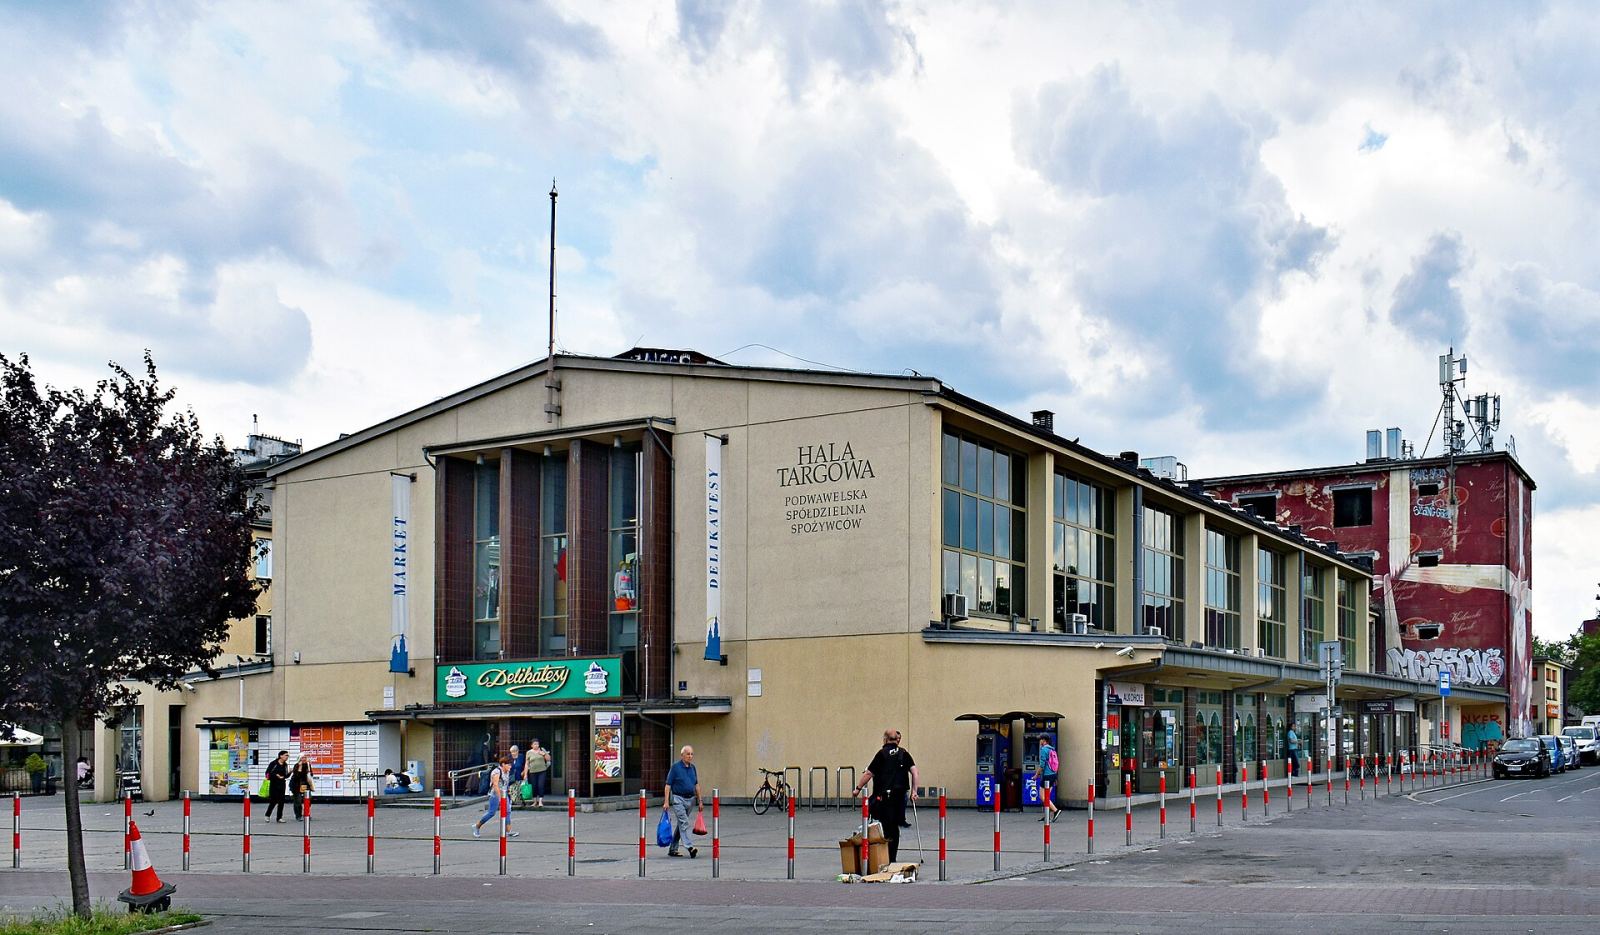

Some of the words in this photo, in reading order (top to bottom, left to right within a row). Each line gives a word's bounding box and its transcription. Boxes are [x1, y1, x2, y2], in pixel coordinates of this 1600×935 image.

[798, 441, 855, 465] HALA
[777, 459, 875, 487] TARGOWA
[785, 489, 868, 507] PODWAWELSKA
[786, 504, 867, 520] SPÓŁDZIELNIA
[708, 469, 719, 589] DELIKATESY
[791, 517, 862, 534] SPOŻYWCÓW
[393, 516, 407, 596] MARKET
[477, 665, 570, 697] Delikatesy
